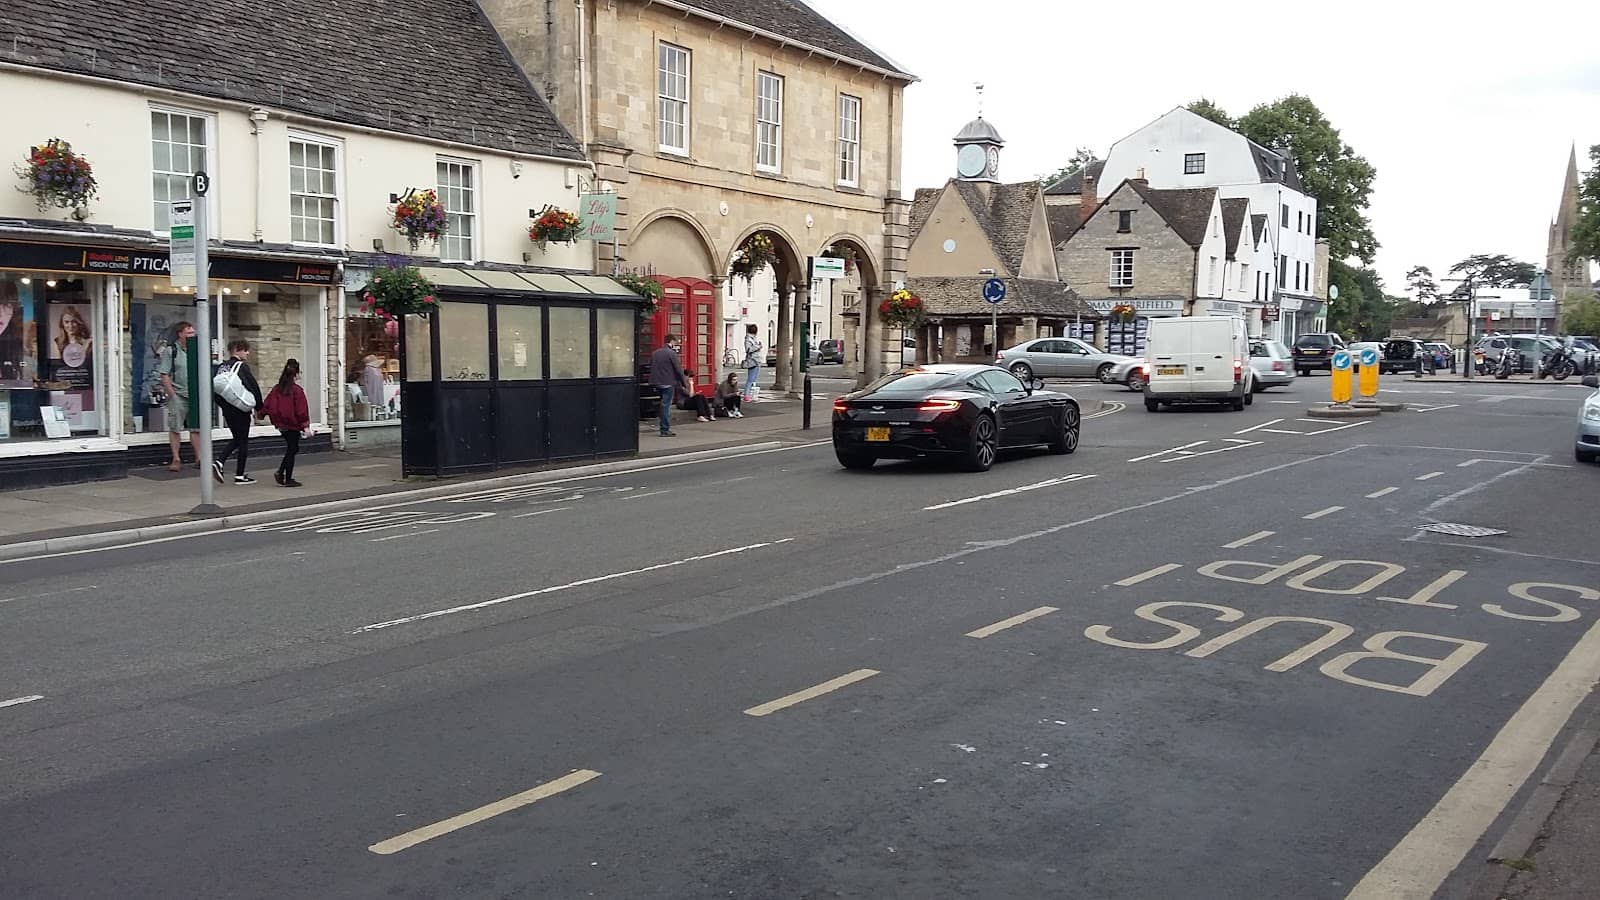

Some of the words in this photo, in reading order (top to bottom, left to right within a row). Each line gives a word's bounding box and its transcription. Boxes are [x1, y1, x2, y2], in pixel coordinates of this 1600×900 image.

[196, 175, 206, 192] B
[133, 256, 171, 271] PTICA
[1197, 554, 1600, 623] STOP
[1084, 601, 1489, 697] BUS
